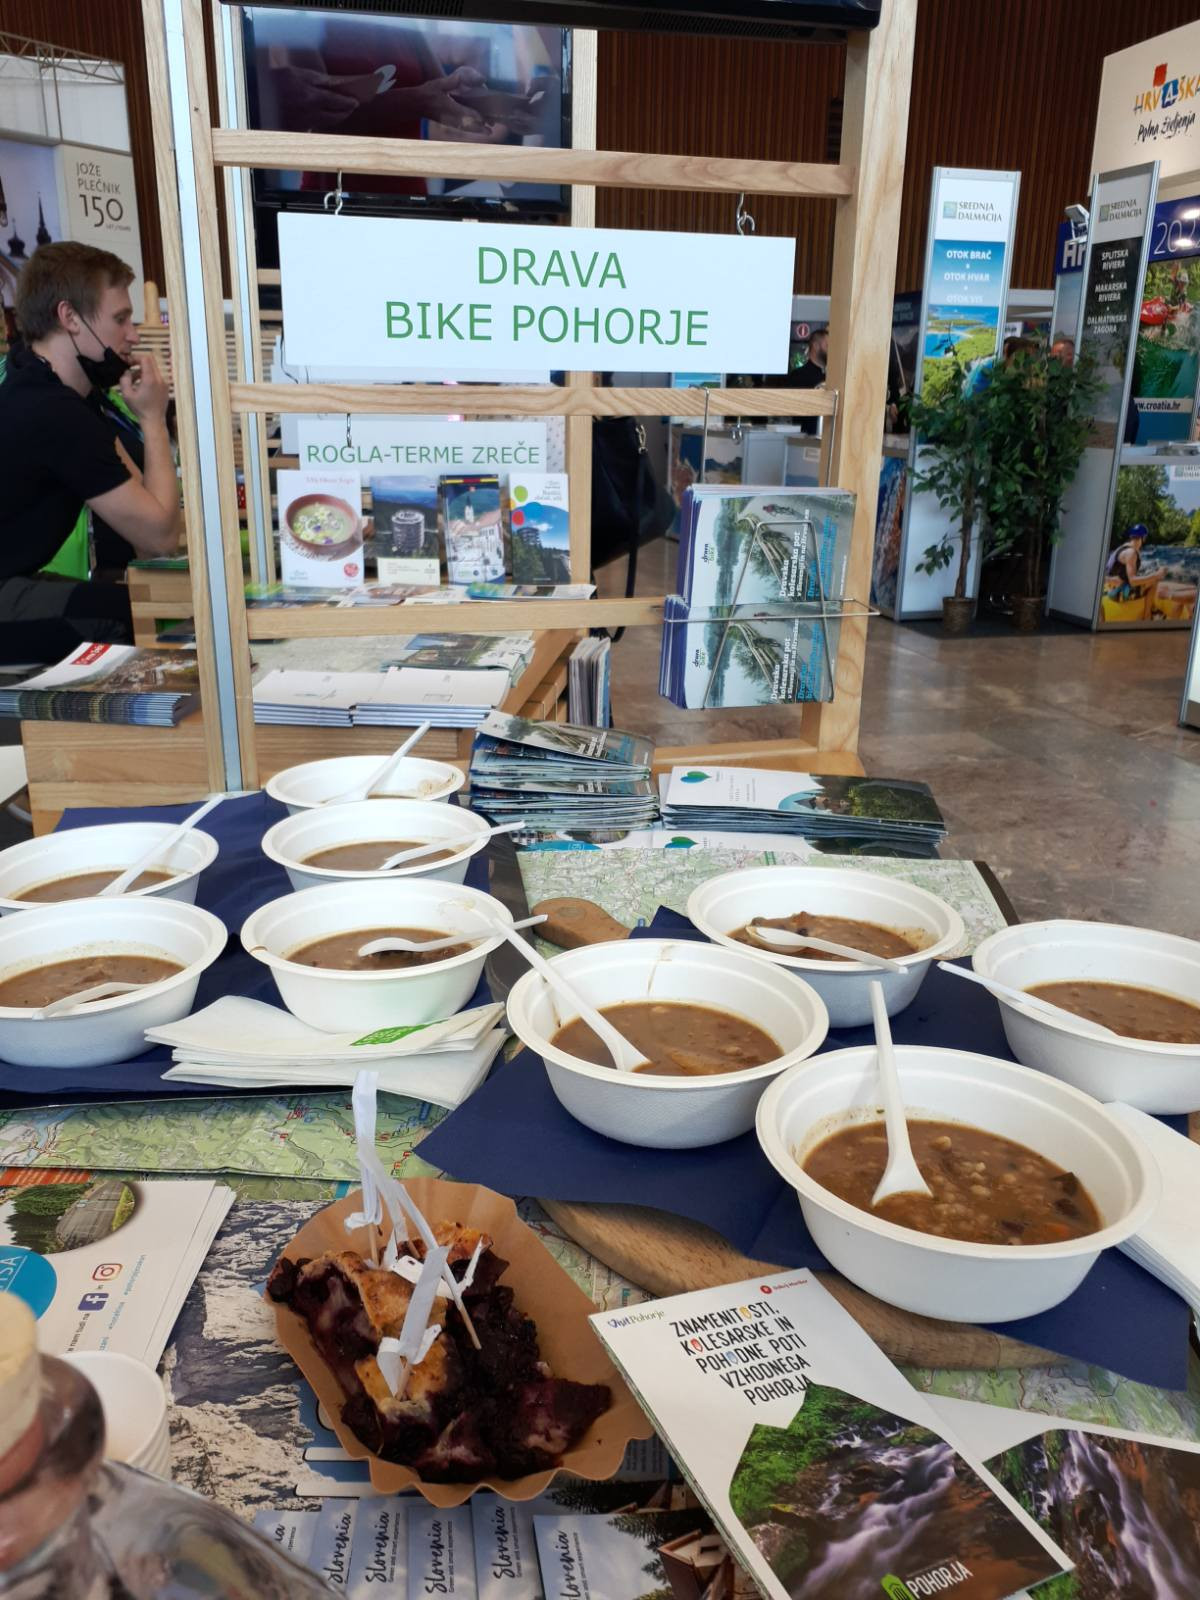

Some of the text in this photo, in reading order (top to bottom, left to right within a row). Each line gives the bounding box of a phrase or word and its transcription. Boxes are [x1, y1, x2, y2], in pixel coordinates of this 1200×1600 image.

[76, 161, 102, 177] JOŽE
[77, 177, 121, 195] PLEČNIK
[79, 194, 124, 228] 150
[958, 212, 1002, 222] DALMACIJA
[959, 201, 995, 212] SREDNJA
[477, 246, 627, 289] DRAVA
[946, 250, 992, 260] OTOK BRAČ
[1101, 249, 1129, 261] SPLITSKA
[1102, 260, 1125, 271] RIVIERA
[944, 272, 990, 281] OTOK HVAR
[1094, 282, 1127, 293] MAKARSKA
[1098, 292, 1121, 303] RIVIERA
[385, 301, 709, 345] BIKE POHORJE
[1093, 325, 1117, 334] ZAGORA
[307, 440, 540, 465] ROGLA-TERME ZREČE
[779, 559, 789, 597] Dravska
[787, 548, 799, 597] kolesarska
[771, 664, 780, 700] Dravska
[779, 654, 789, 700] kolesarska
[777, 1316, 795, 1331] IN
[768, 1333, 808, 1355] POTI
[719, 1353, 812, 1389] VZHODNEGA
[743, 1373, 813, 1406] POHORJA
[365, 1511, 390, 1583] Slovenia
[424, 1519, 448, 1594] Slovenia
[491, 1504, 516, 1580] Slovenia
[555, 1529, 581, 1600] lovenia
[905, 1560, 974, 1600] POHORJA
